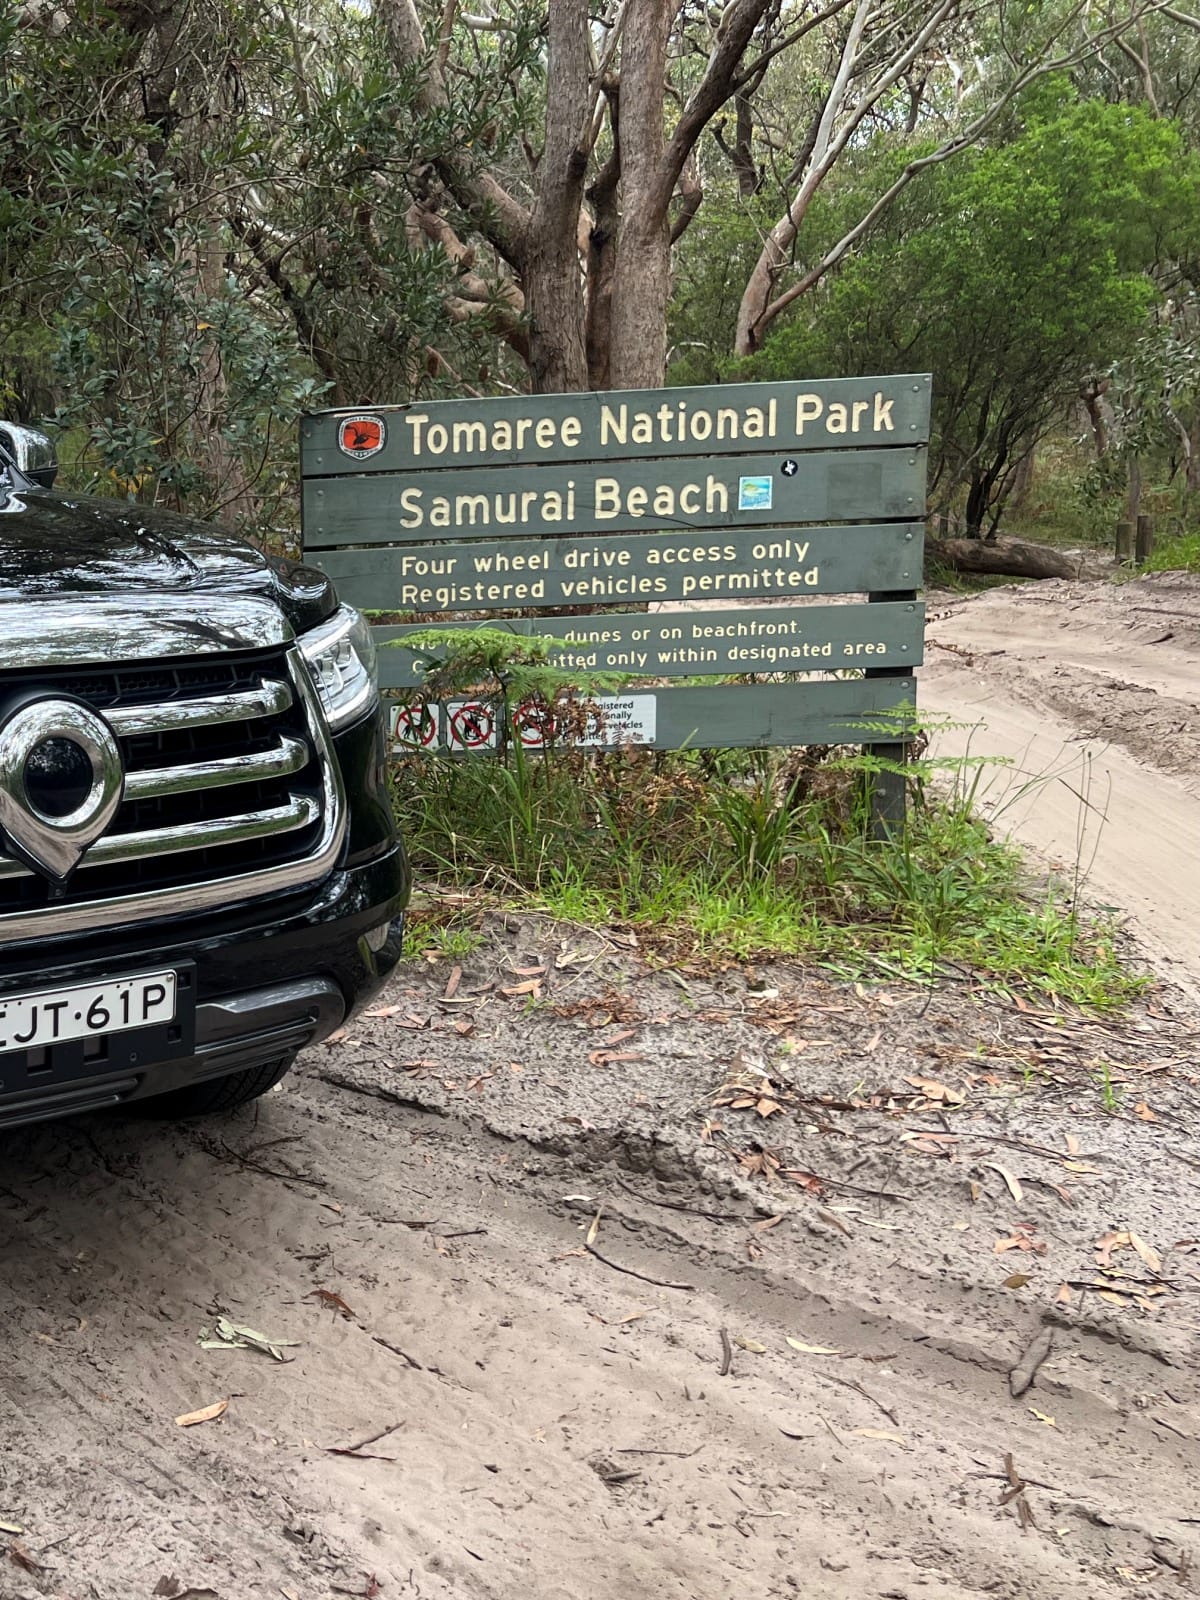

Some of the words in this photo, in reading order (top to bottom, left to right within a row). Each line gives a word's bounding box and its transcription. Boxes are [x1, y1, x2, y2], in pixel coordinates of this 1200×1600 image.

[404, 413, 582, 456] Tomaree
[599, 398, 777, 446] National
[795, 391, 896, 436] Park
[399, 480, 576, 529] Samurai
[593, 474, 729, 520] Beach
[401, 555, 458, 577] Four
[472, 550, 550, 573] wheel
[563, 547, 632, 569] drive
[646, 543, 737, 564] access
[752, 539, 811, 563] only
[401, 578, 546, 609] Registered
[560, 574, 668, 597] vehicles
[682, 566, 820, 596] permitted
[564, 629, 622, 643] dunes
[631, 629, 651, 642] or
[659, 627, 683, 640] on
[692, 619, 803, 639] beachfront.
[606, 650, 648, 668] only
[657, 646, 718, 664] within
[727, 642, 833, 663] designated
[843, 642, 887, 655] area
